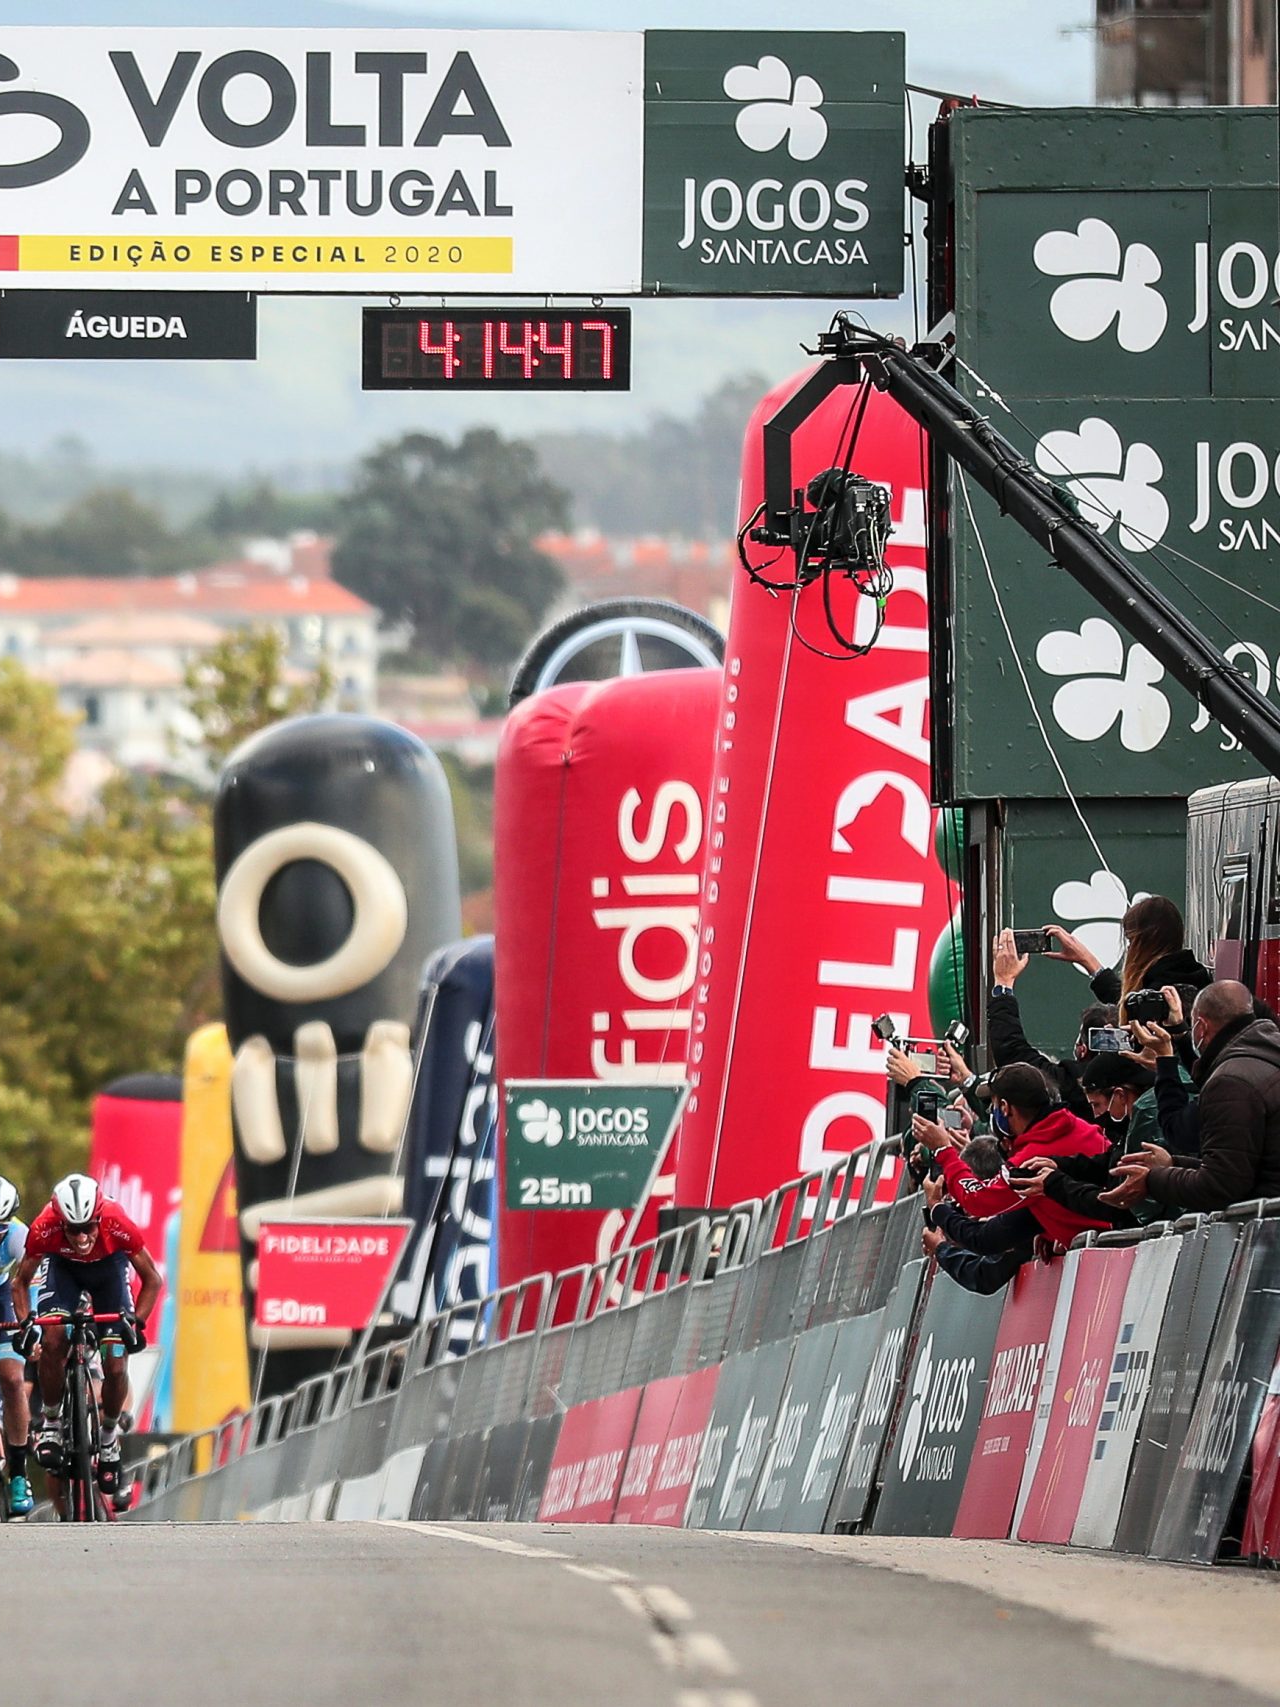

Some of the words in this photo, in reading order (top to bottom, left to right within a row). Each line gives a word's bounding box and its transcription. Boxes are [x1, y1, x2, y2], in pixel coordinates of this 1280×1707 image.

[108, 50, 513, 148] VOLTA
[111, 168, 158, 216] A
[175, 168, 514, 217] PORTUGAL
[677, 178, 871, 250] JOGOS
[69, 241, 193, 268] EDIÇÃO
[211, 244, 368, 264] ESPECIAL
[384, 244, 465, 264] 2020
[700, 239, 871, 266] SANTACASA
[65, 310, 188, 339] ÁGUEDA
[687, 924, 716, 1113] SEGUROS
[707, 776, 730, 904] DESDE
[721, 656, 742, 752] 1808
[568, 1107, 649, 1140] JOGOS
[577, 1132, 649, 1146] SANTACASA
[520, 1177, 592, 1205] 25m
[265, 1235, 390, 1255] FIDELIDADE
[263, 1299, 326, 1325] 50m
